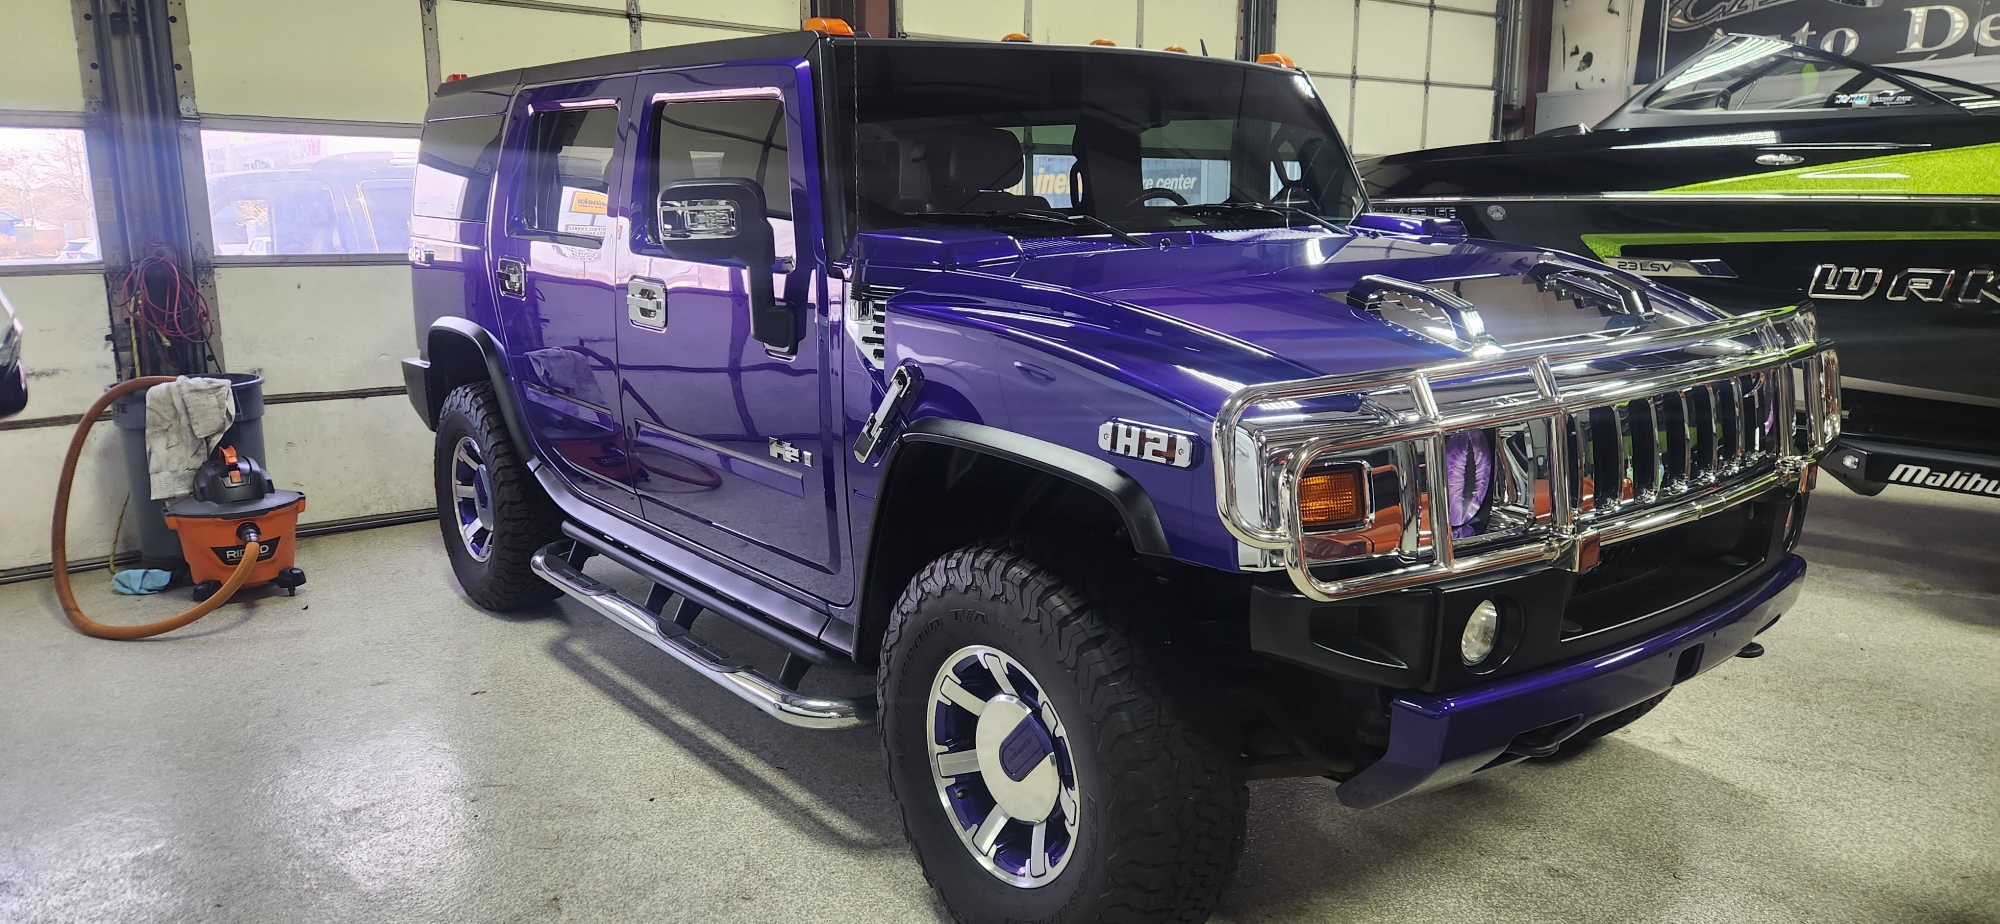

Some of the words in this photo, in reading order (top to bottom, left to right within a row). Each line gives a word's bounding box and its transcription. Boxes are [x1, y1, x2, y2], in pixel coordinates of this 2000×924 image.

[1155, 173, 1198, 191] center
[1617, 261, 1673, 272] 23LSV
[1116, 422, 1169, 465] H2
